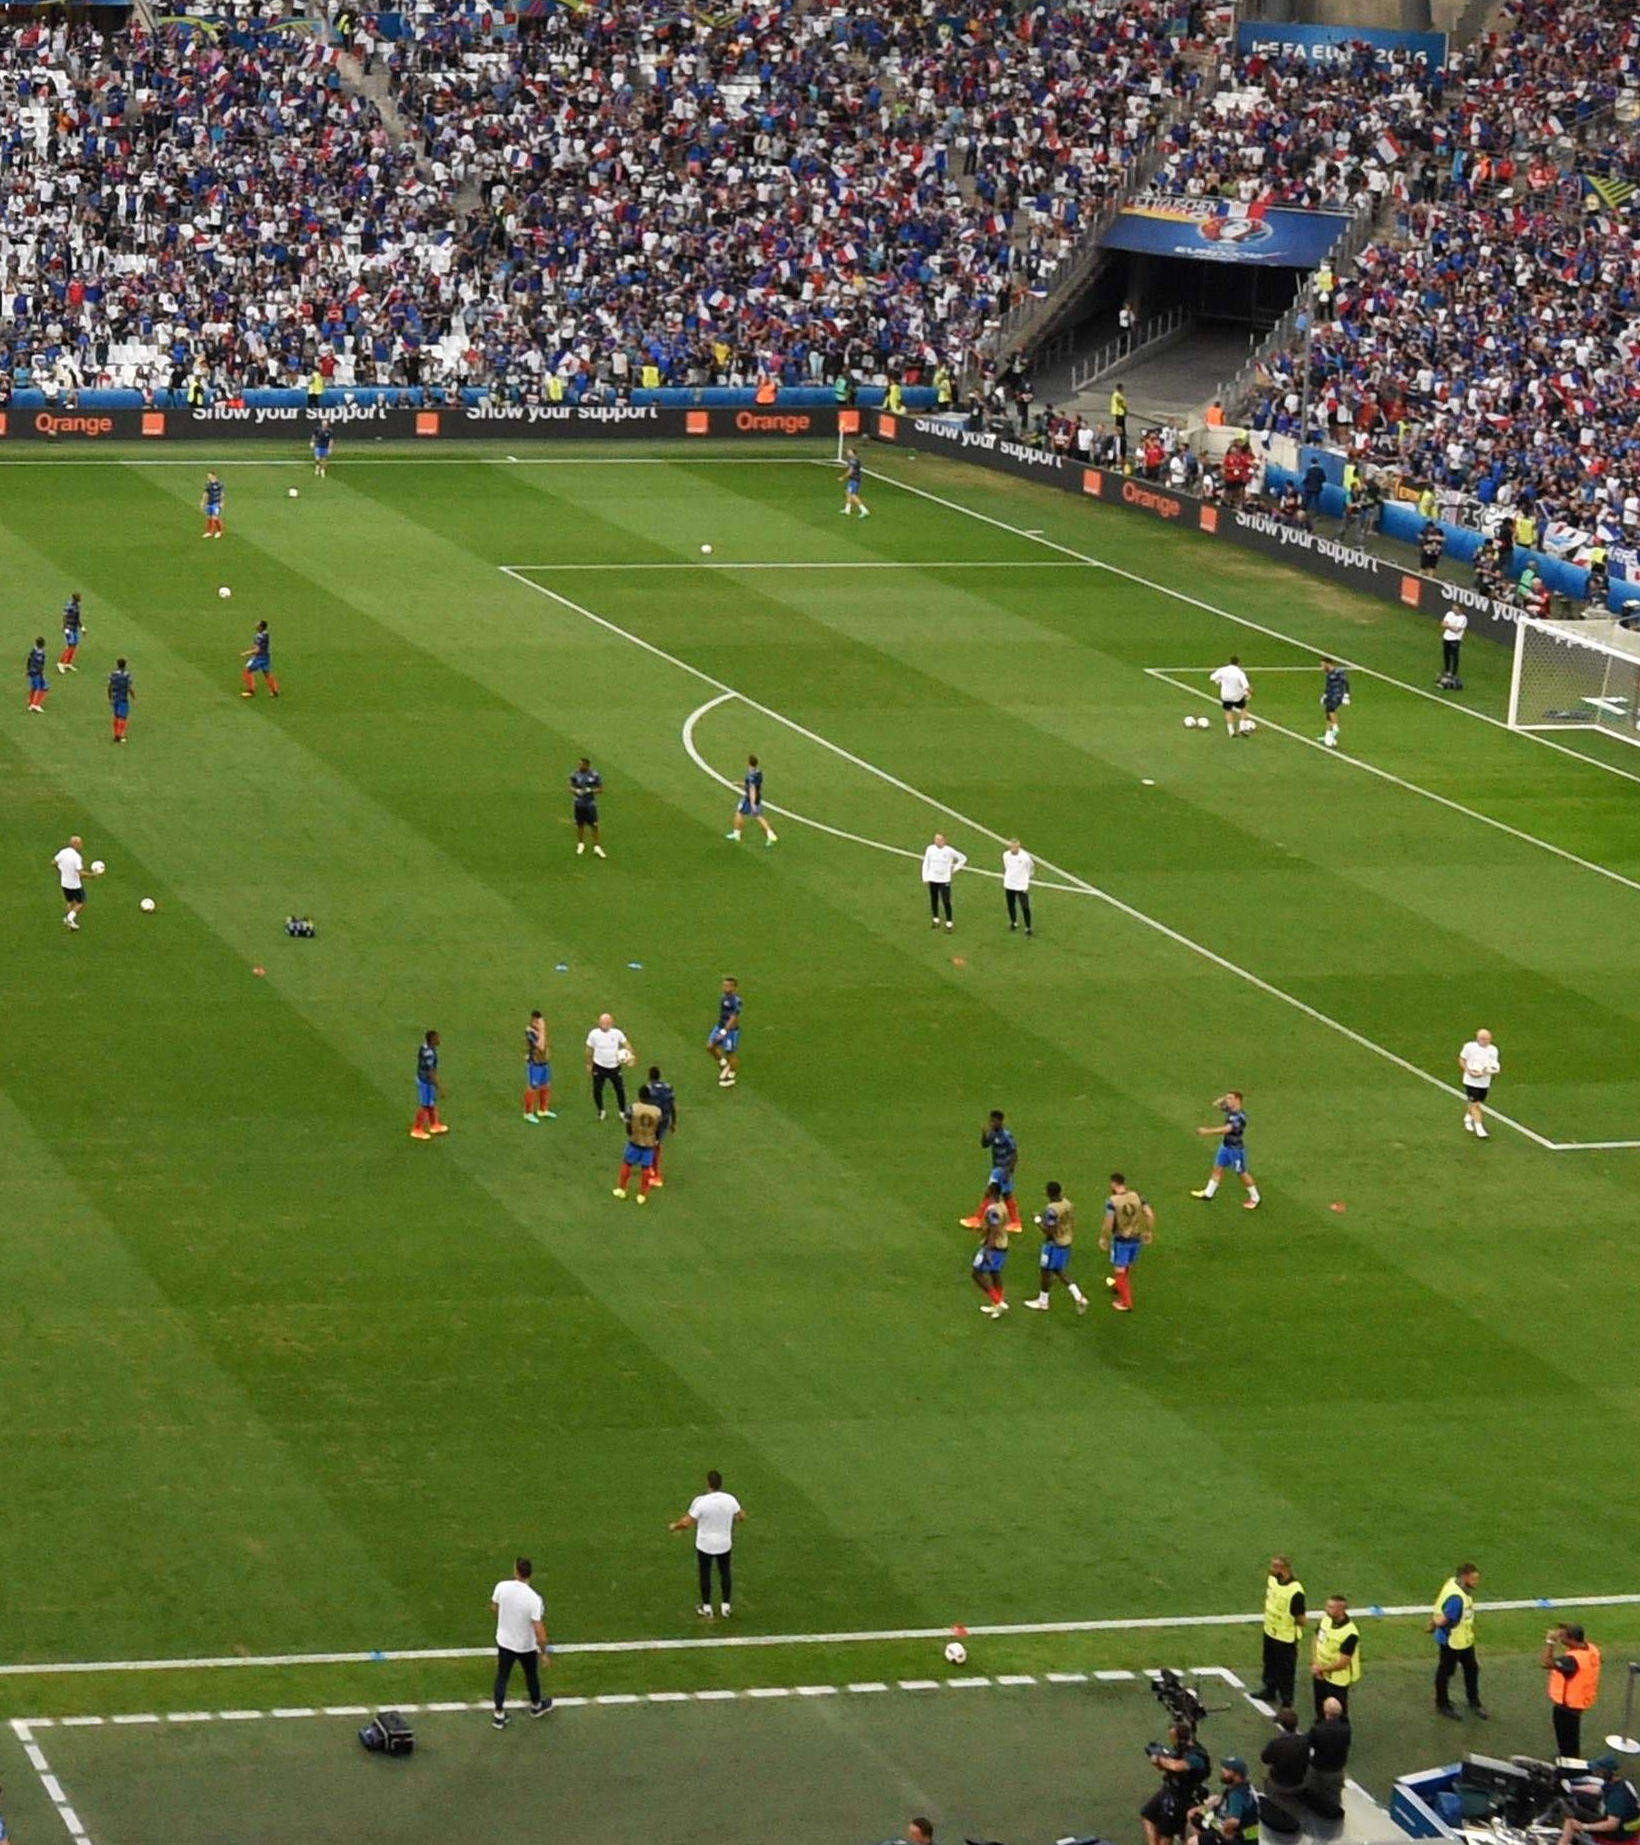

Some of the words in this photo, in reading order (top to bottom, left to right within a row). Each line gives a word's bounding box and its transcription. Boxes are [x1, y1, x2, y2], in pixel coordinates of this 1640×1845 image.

[35, 413, 113, 437] Orange
[737, 412, 810, 434] Orange
[1121, 481, 1181, 518] Orange
